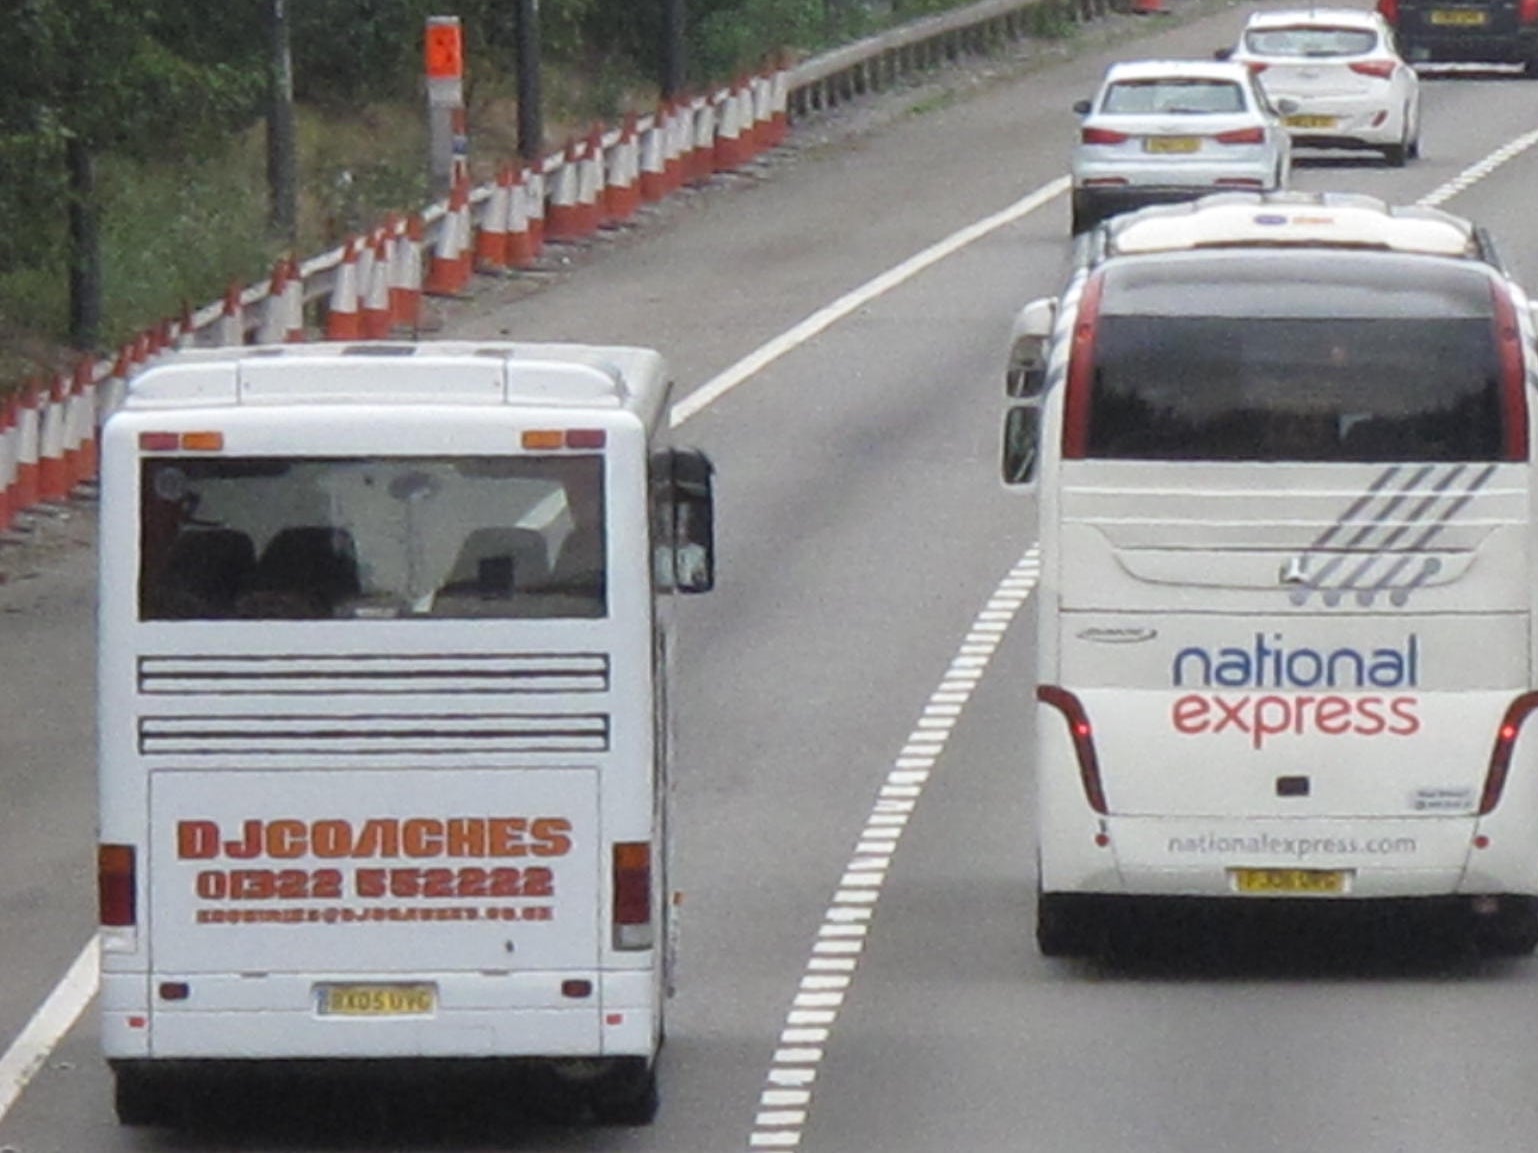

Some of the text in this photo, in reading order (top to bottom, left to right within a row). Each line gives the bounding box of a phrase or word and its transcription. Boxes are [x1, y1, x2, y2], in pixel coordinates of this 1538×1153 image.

[1172, 632, 1418, 688] national
[1172, 694, 1420, 750] express
[1168, 831, 1417, 859] nationalexpress.com
[196, 866, 554, 900] 01322 552222
